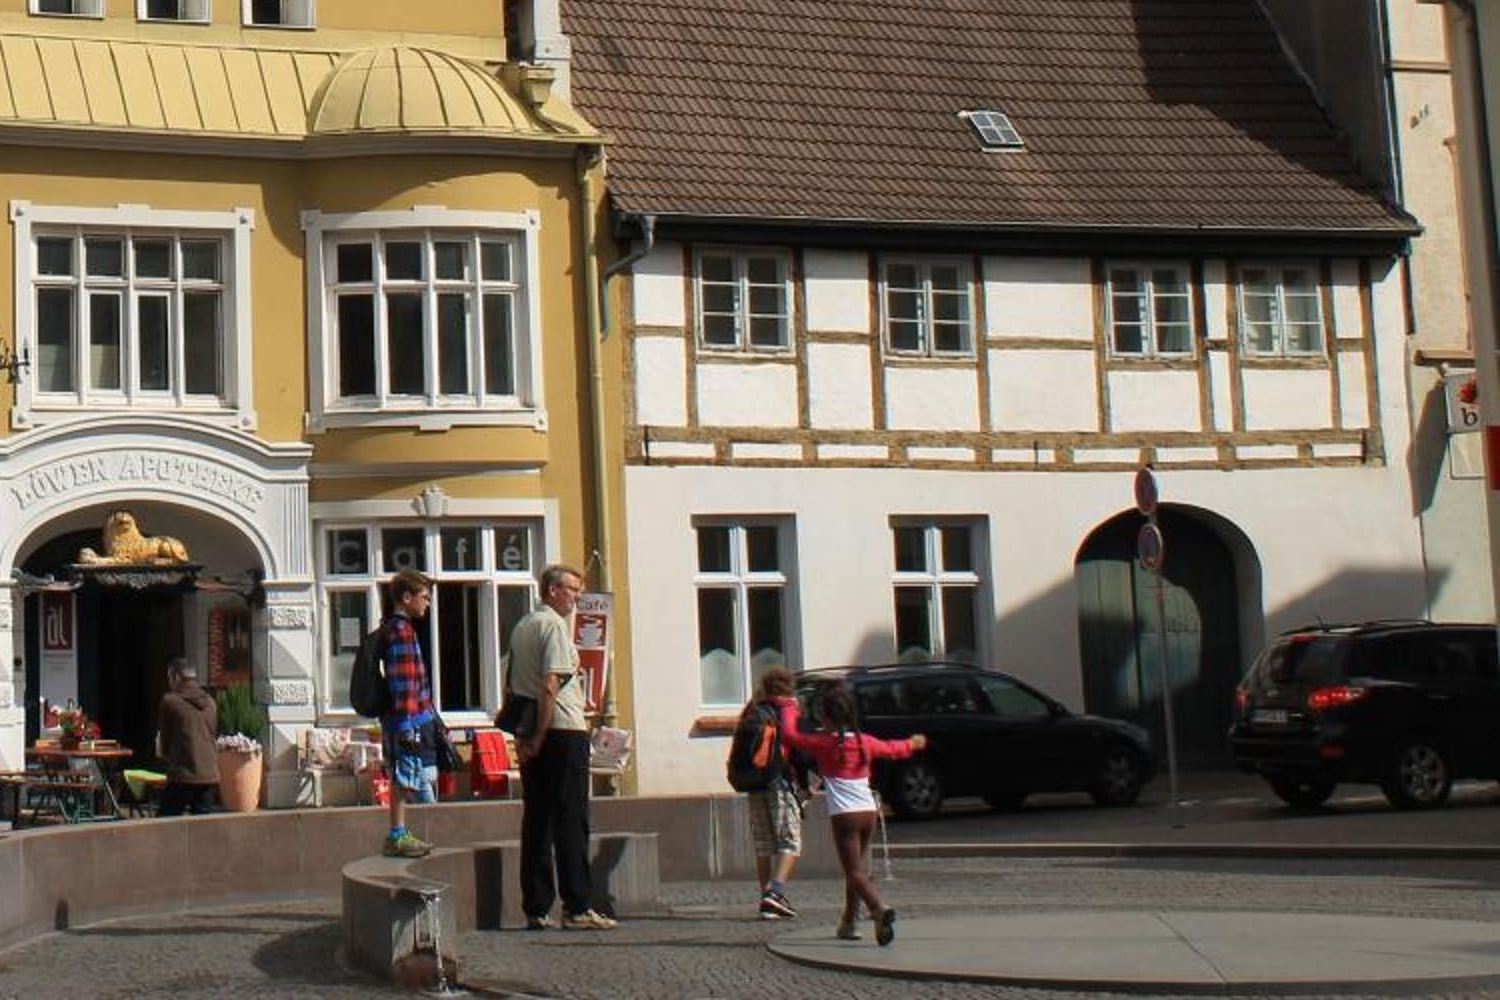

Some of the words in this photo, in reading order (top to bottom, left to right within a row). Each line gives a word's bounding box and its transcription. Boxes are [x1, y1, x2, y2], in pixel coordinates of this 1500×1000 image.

[11, 457, 108, 511] LÖWEN
[119, 454, 265, 514] APOTHEKE
[335, 535, 522, 573] Café
